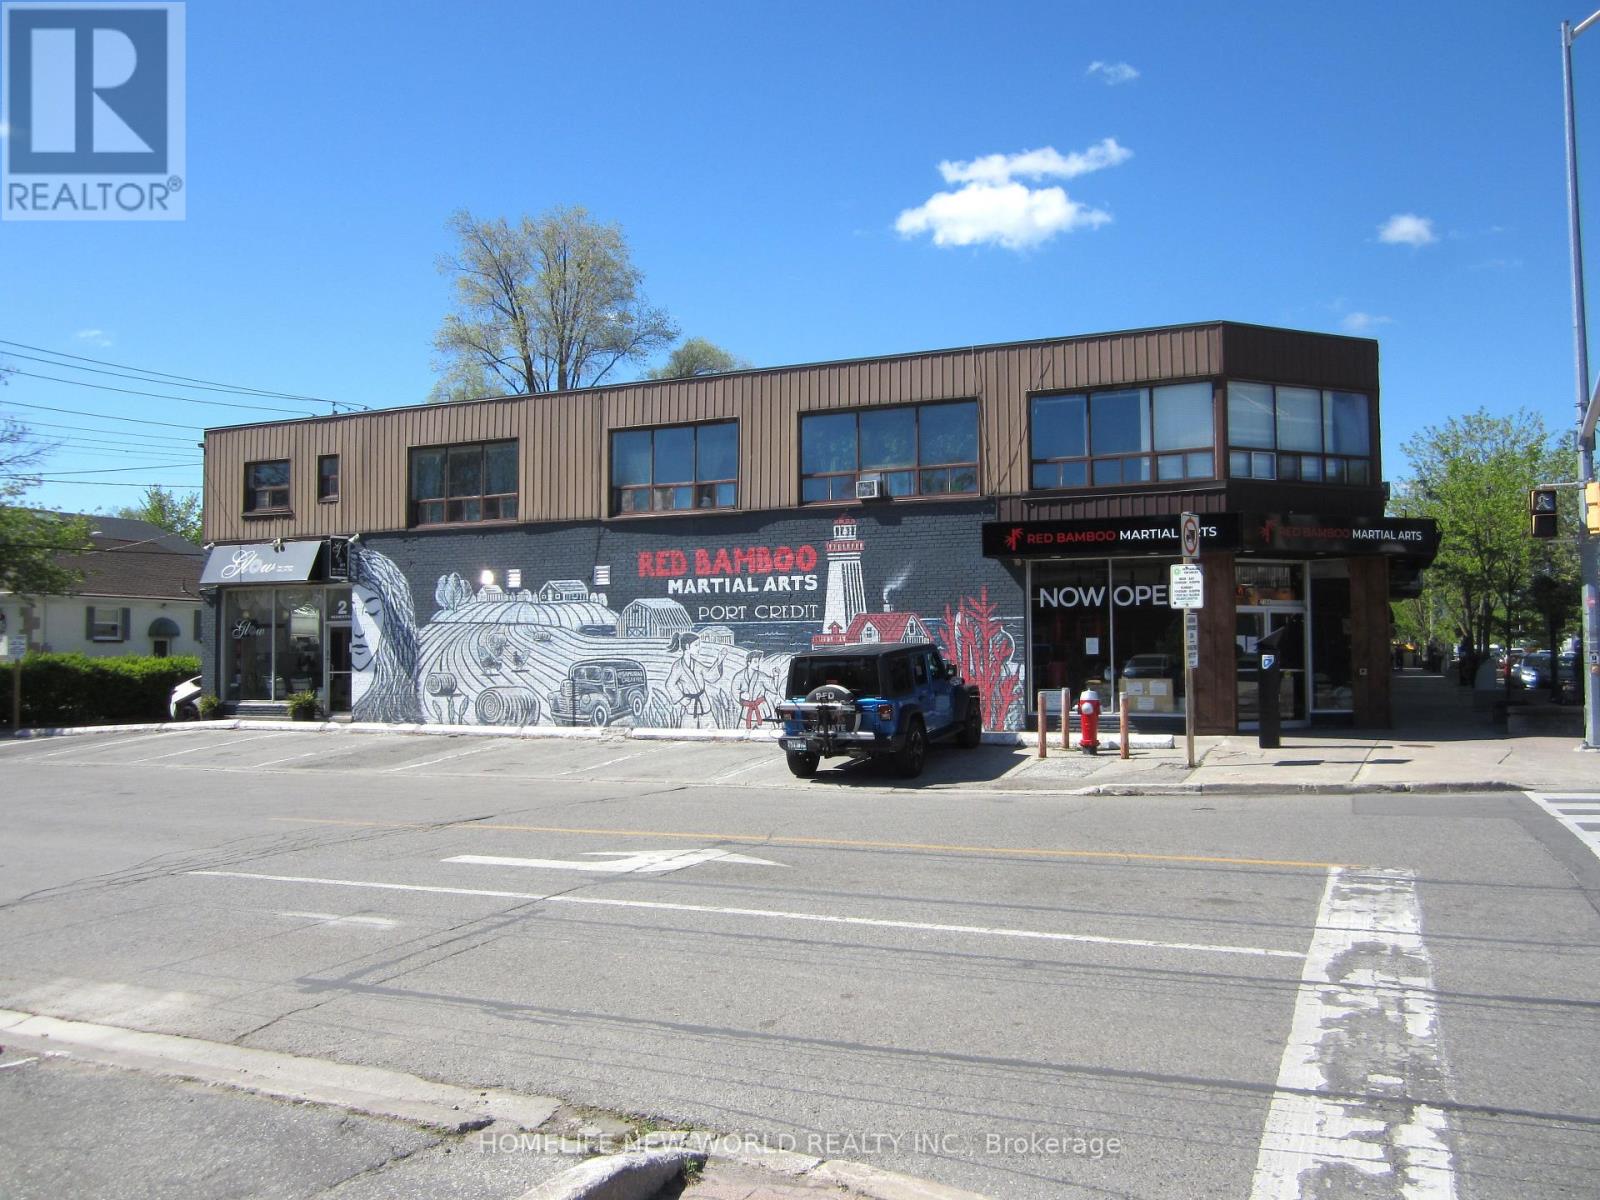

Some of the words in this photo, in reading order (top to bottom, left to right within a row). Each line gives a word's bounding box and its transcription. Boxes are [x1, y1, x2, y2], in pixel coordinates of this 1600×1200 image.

[1026, 532, 1053, 545] RED
[1057, 529, 1117, 544] BAMBOO
[1119, 527, 1179, 541] MARTIAL
[1352, 529, 1396, 540] MARTIAL
[1397, 530, 1423, 541] ARTS
[221, 549, 277, 579] Glow
[637, 550, 689, 578] RED
[695, 544, 818, 577] BAMBOO
[667, 576, 759, 595] MARTIAL
[763, 574, 818, 593] ARTS
[1039, 585, 1105, 608] NOW
[1113, 584, 1168, 607] OPE
[337, 600, 348, 615] 2
[698, 605, 748, 620] PORT
[754, 604, 819, 619] CREDIT
